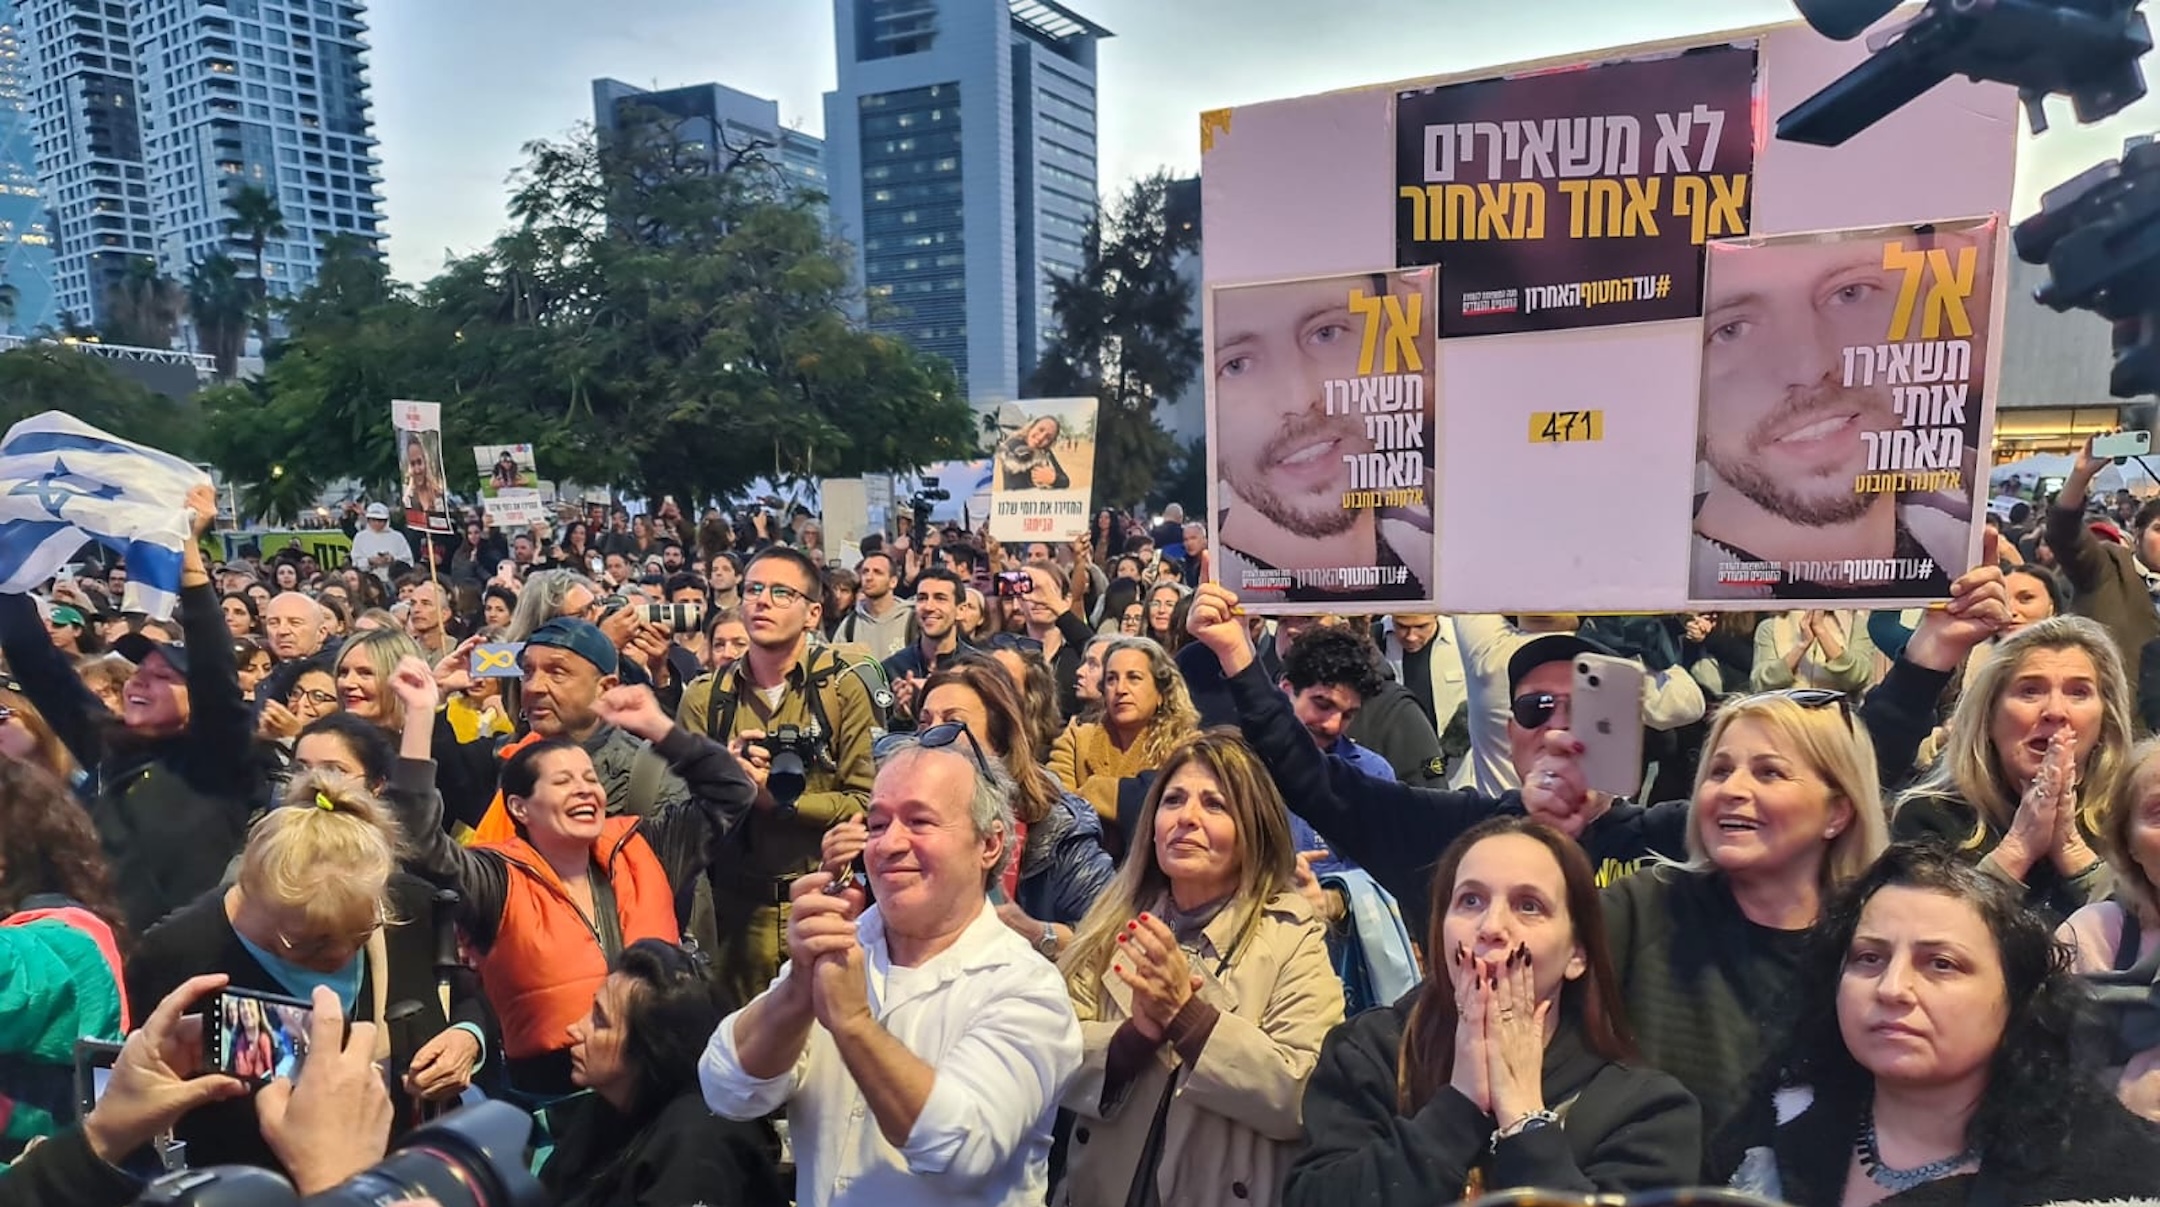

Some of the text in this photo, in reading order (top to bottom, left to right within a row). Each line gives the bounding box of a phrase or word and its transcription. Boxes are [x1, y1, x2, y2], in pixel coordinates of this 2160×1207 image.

[1424, 104, 1725, 182] לא משאירים
[1400, 174, 1747, 245] אף אחד מאחור
[1883, 241, 1977, 341] אל
[1348, 288, 1424, 376] אל
[1842, 340, 1972, 388] תשאירו
[1324, 374, 1424, 416] תשאירו
[1892, 384, 1968, 428] אותי
[1365, 412, 1424, 451] אותי
[1541, 410, 1591, 441] 471
[1343, 451, 1424, 490] מאחור
[1860, 428, 1964, 472] מאחור
[1342, 487, 1424, 509] אלקנה בוחבוט
[1854, 468, 1962, 493] אלקנה בוחבוט
[998, 501, 1018, 516] שלנו
[1039, 501, 1052, 515] את
